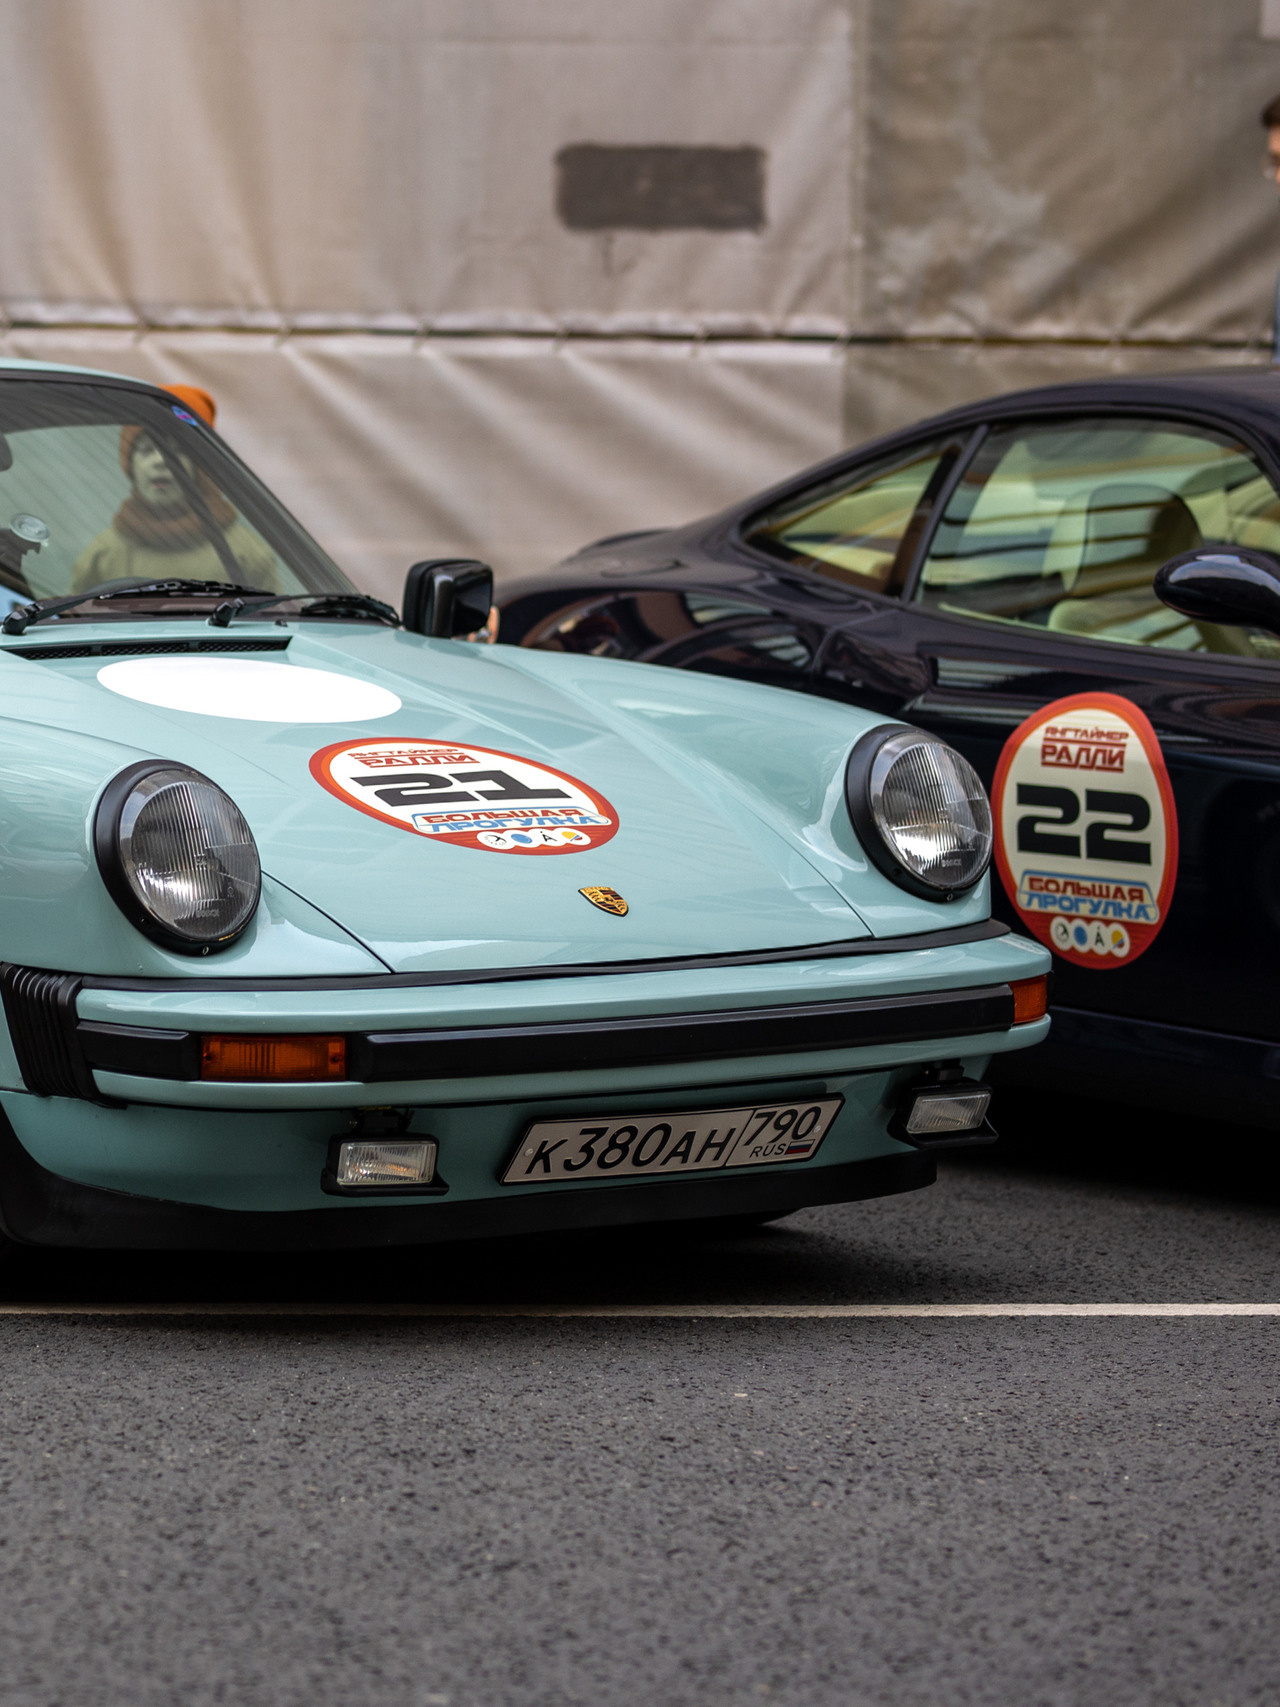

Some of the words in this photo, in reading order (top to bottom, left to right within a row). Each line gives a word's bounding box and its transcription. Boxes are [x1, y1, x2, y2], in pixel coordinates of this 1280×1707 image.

[1044, 725, 1130, 741] ЯНГТАЙМЕР
[358, 753, 480, 768] РАЛЛИ
[1041, 743, 1125, 773] РАЛЛИ
[349, 769, 573, 808] 21
[421, 807, 588, 824] БОЛЬШАЯ
[422, 815, 609, 833] ПРОГУЛКА
[1016, 782, 1152, 866] 22
[1028, 876, 1144, 904] БОЛЬШАЯ
[1025, 893, 1151, 922] ПРОГУЛКА
[743, 1106, 822, 1147] 790
[748, 1142, 786, 1159] RUS
